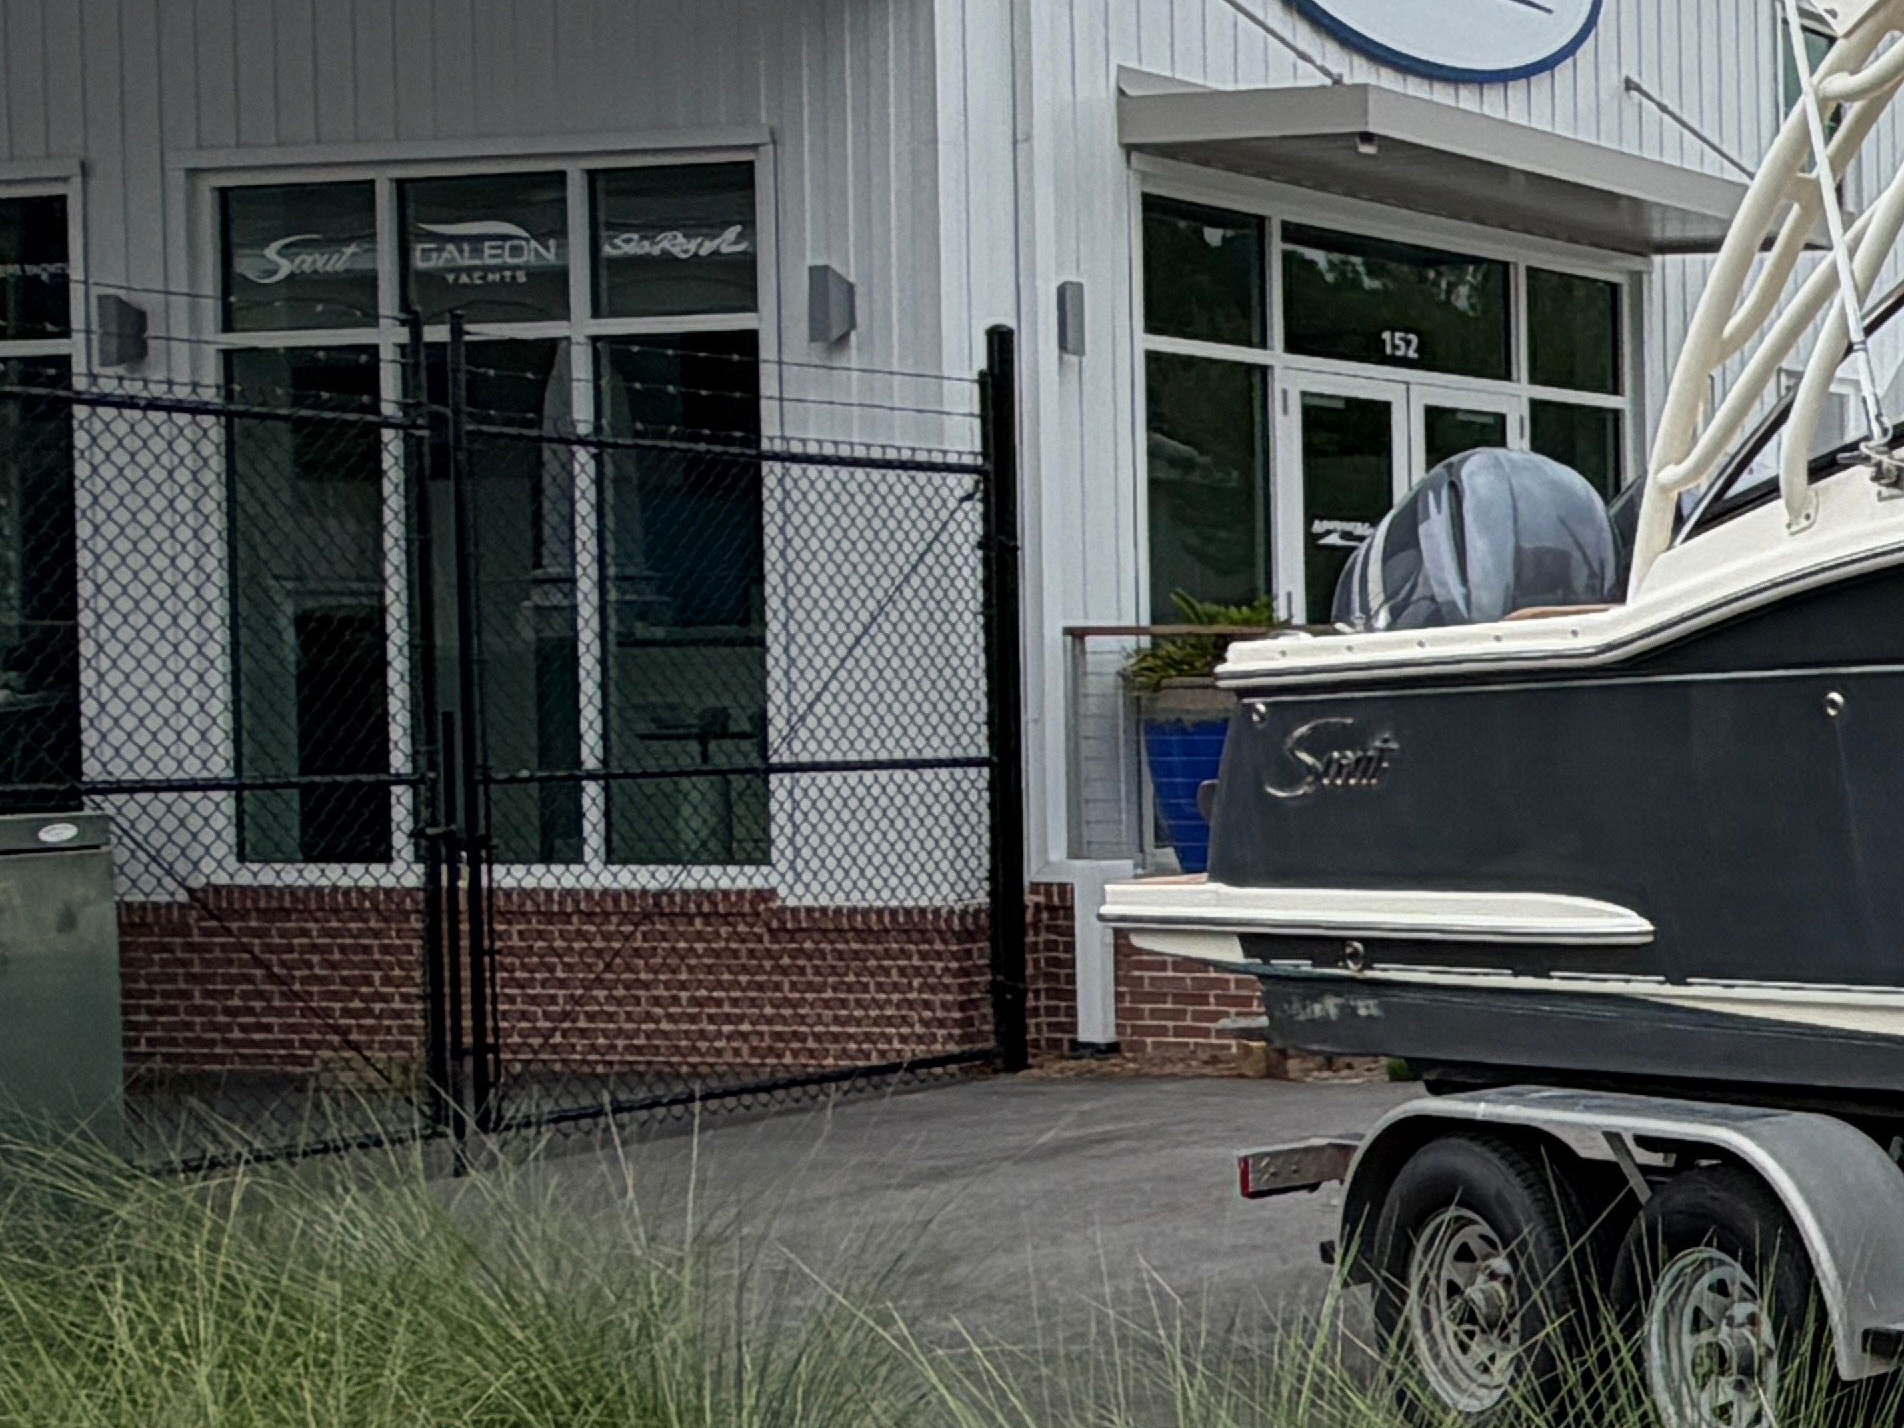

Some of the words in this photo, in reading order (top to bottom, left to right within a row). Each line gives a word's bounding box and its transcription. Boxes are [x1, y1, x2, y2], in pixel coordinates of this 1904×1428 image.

[237, 234, 360, 284] Scout
[415, 239, 557, 269] GALEON
[445, 271, 528, 285] YACHTS
[1381, 330, 1420, 360] 152
